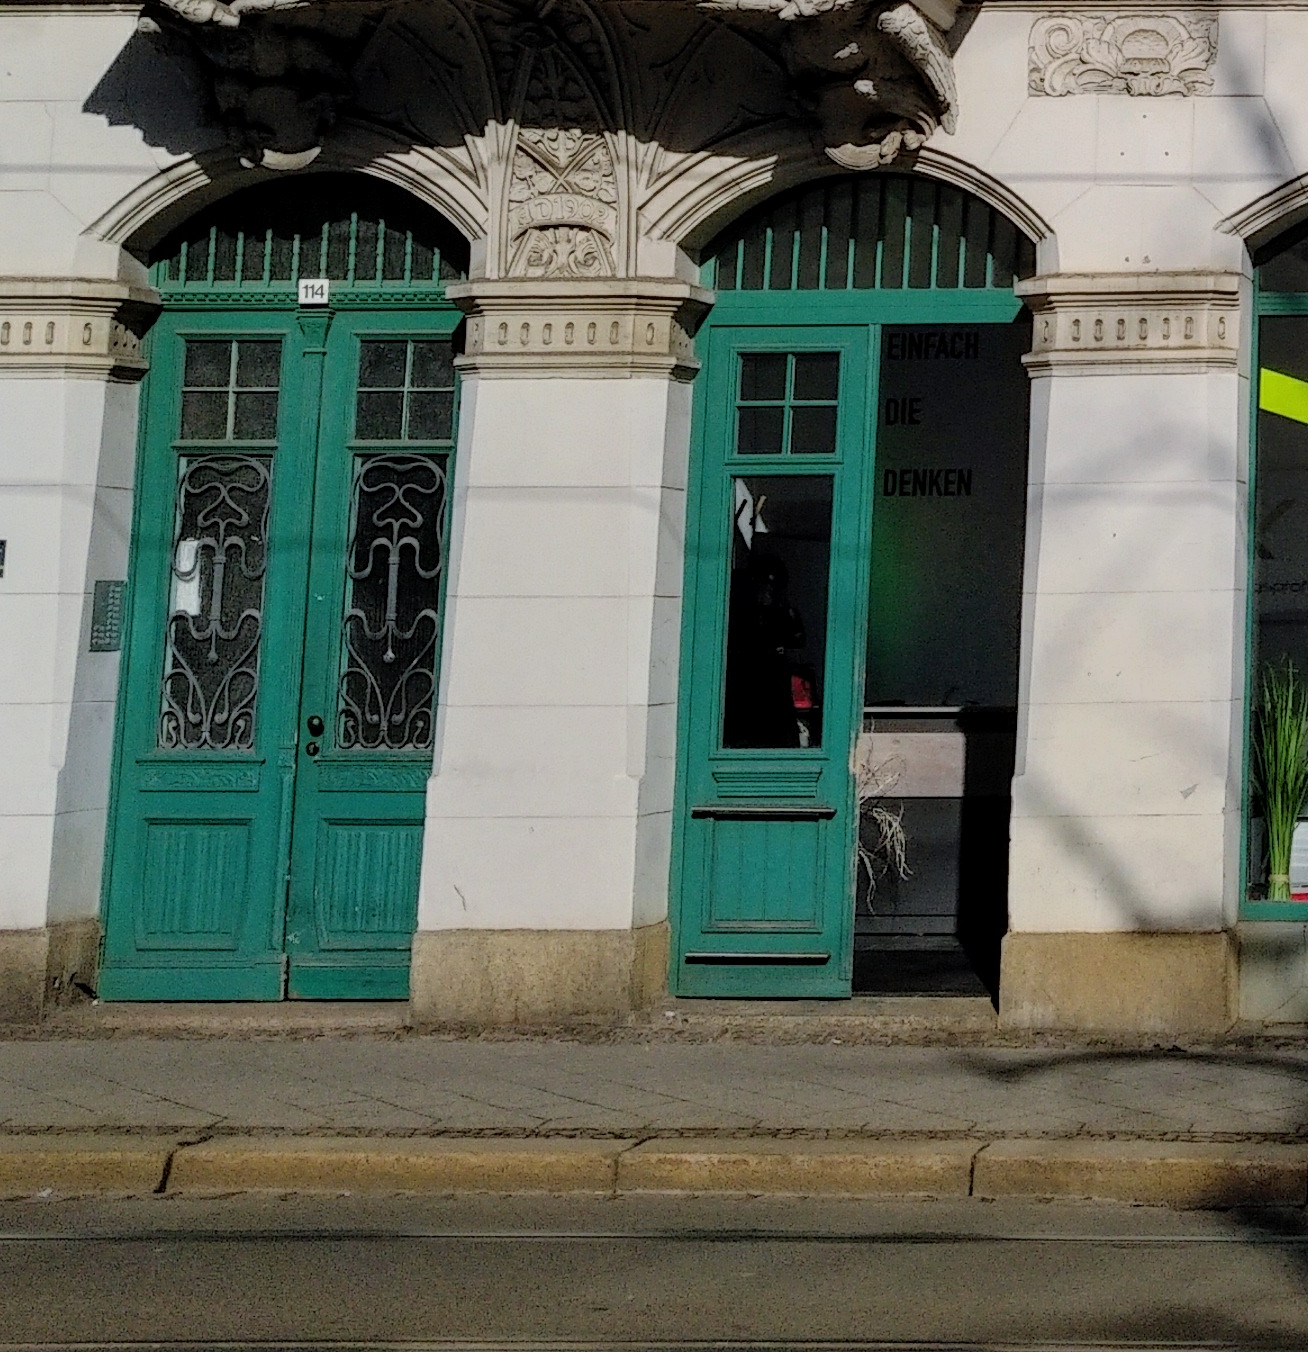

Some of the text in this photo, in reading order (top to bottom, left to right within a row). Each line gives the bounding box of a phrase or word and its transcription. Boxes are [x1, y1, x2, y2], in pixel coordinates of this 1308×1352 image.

[302, 284, 325, 299] 114
[887, 332, 980, 360] EINFACH
[885, 399, 922, 426] DIE
[883, 469, 973, 497] DENKEN
